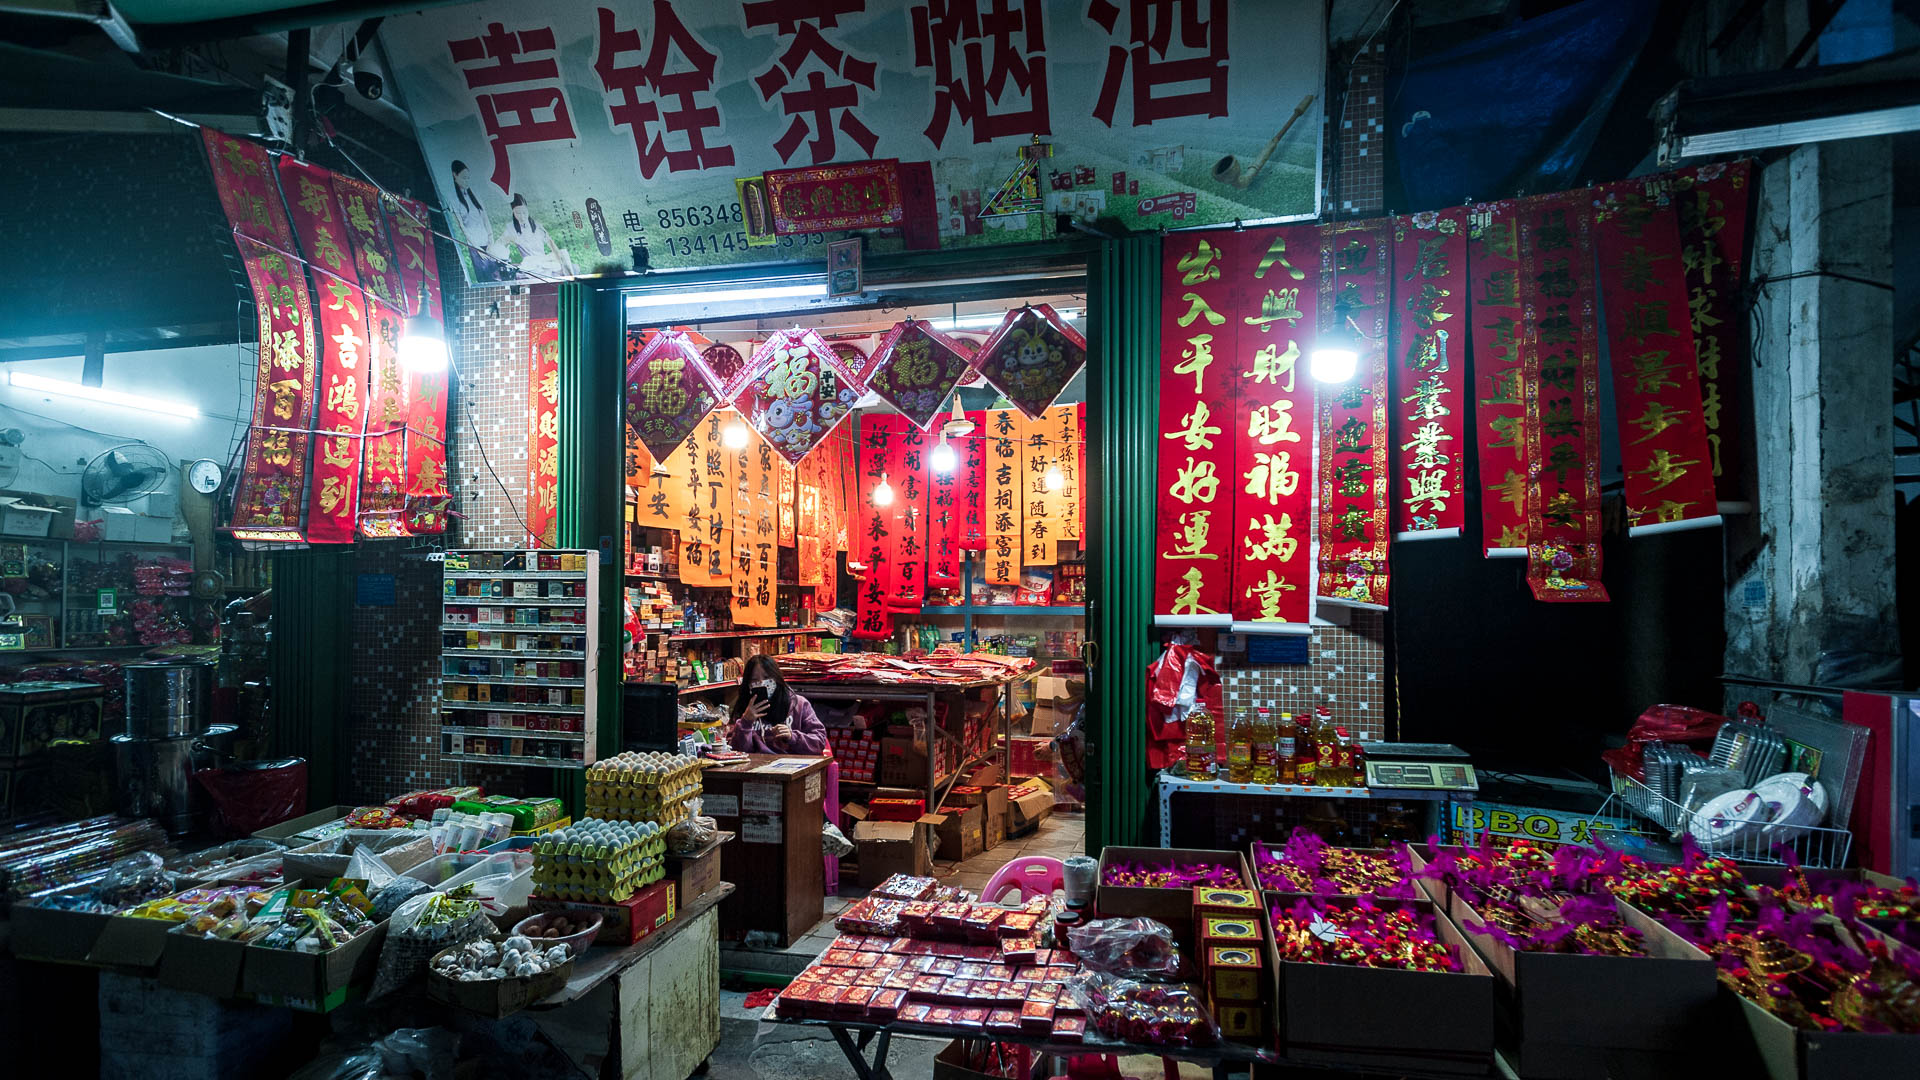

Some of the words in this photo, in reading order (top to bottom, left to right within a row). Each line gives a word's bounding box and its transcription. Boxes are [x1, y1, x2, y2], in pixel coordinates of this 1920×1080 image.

[298, 175, 362, 518] 新春大吉鴻運到
[765, 346, 818, 400] 福
[893, 338, 939, 387] 福
[641, 357, 688, 416] 福
[820, 370, 836, 399] 平安
[707, 411, 724, 575] 高照丁財旺
[1456, 806, 1561, 840] BBQ
